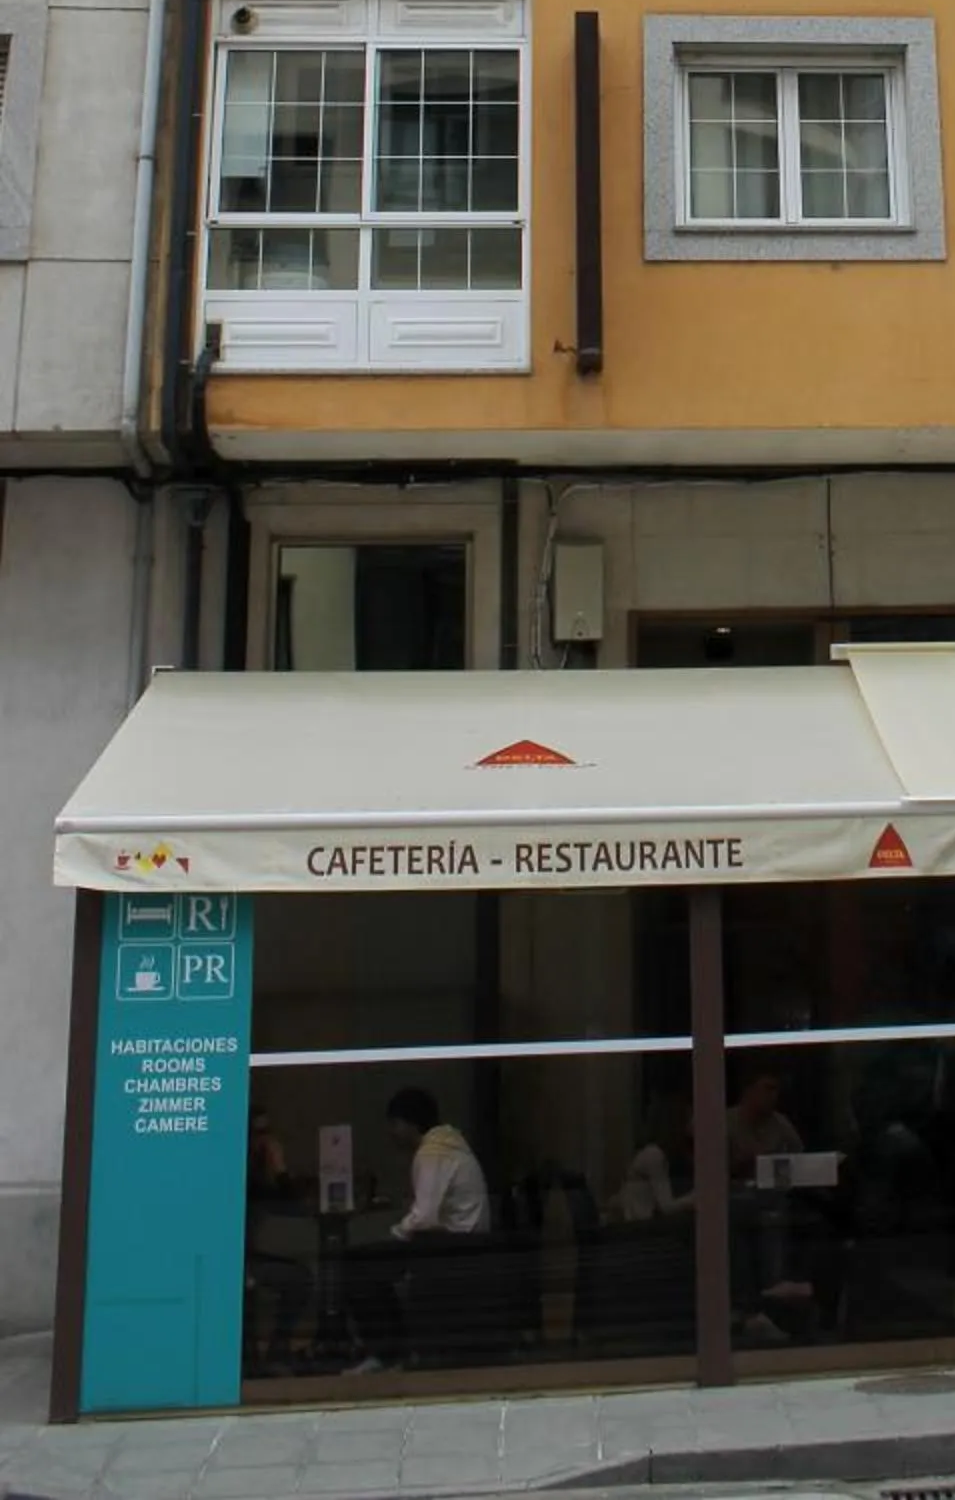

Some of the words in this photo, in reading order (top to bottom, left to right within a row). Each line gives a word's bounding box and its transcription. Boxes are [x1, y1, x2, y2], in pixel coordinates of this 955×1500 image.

[306, 840, 479, 876] CAFETERÍA
[515, 838, 744, 873] RESTAURANTE
[182, 953, 229, 984] PR
[110, 1037, 239, 1055] HABITACIONES
[141, 1057, 206, 1073] ROOMS
[123, 1076, 222, 1094] CHAMBRES
[137, 1097, 206, 1114] ZIMMER
[134, 1116, 209, 1134] CAMERE
